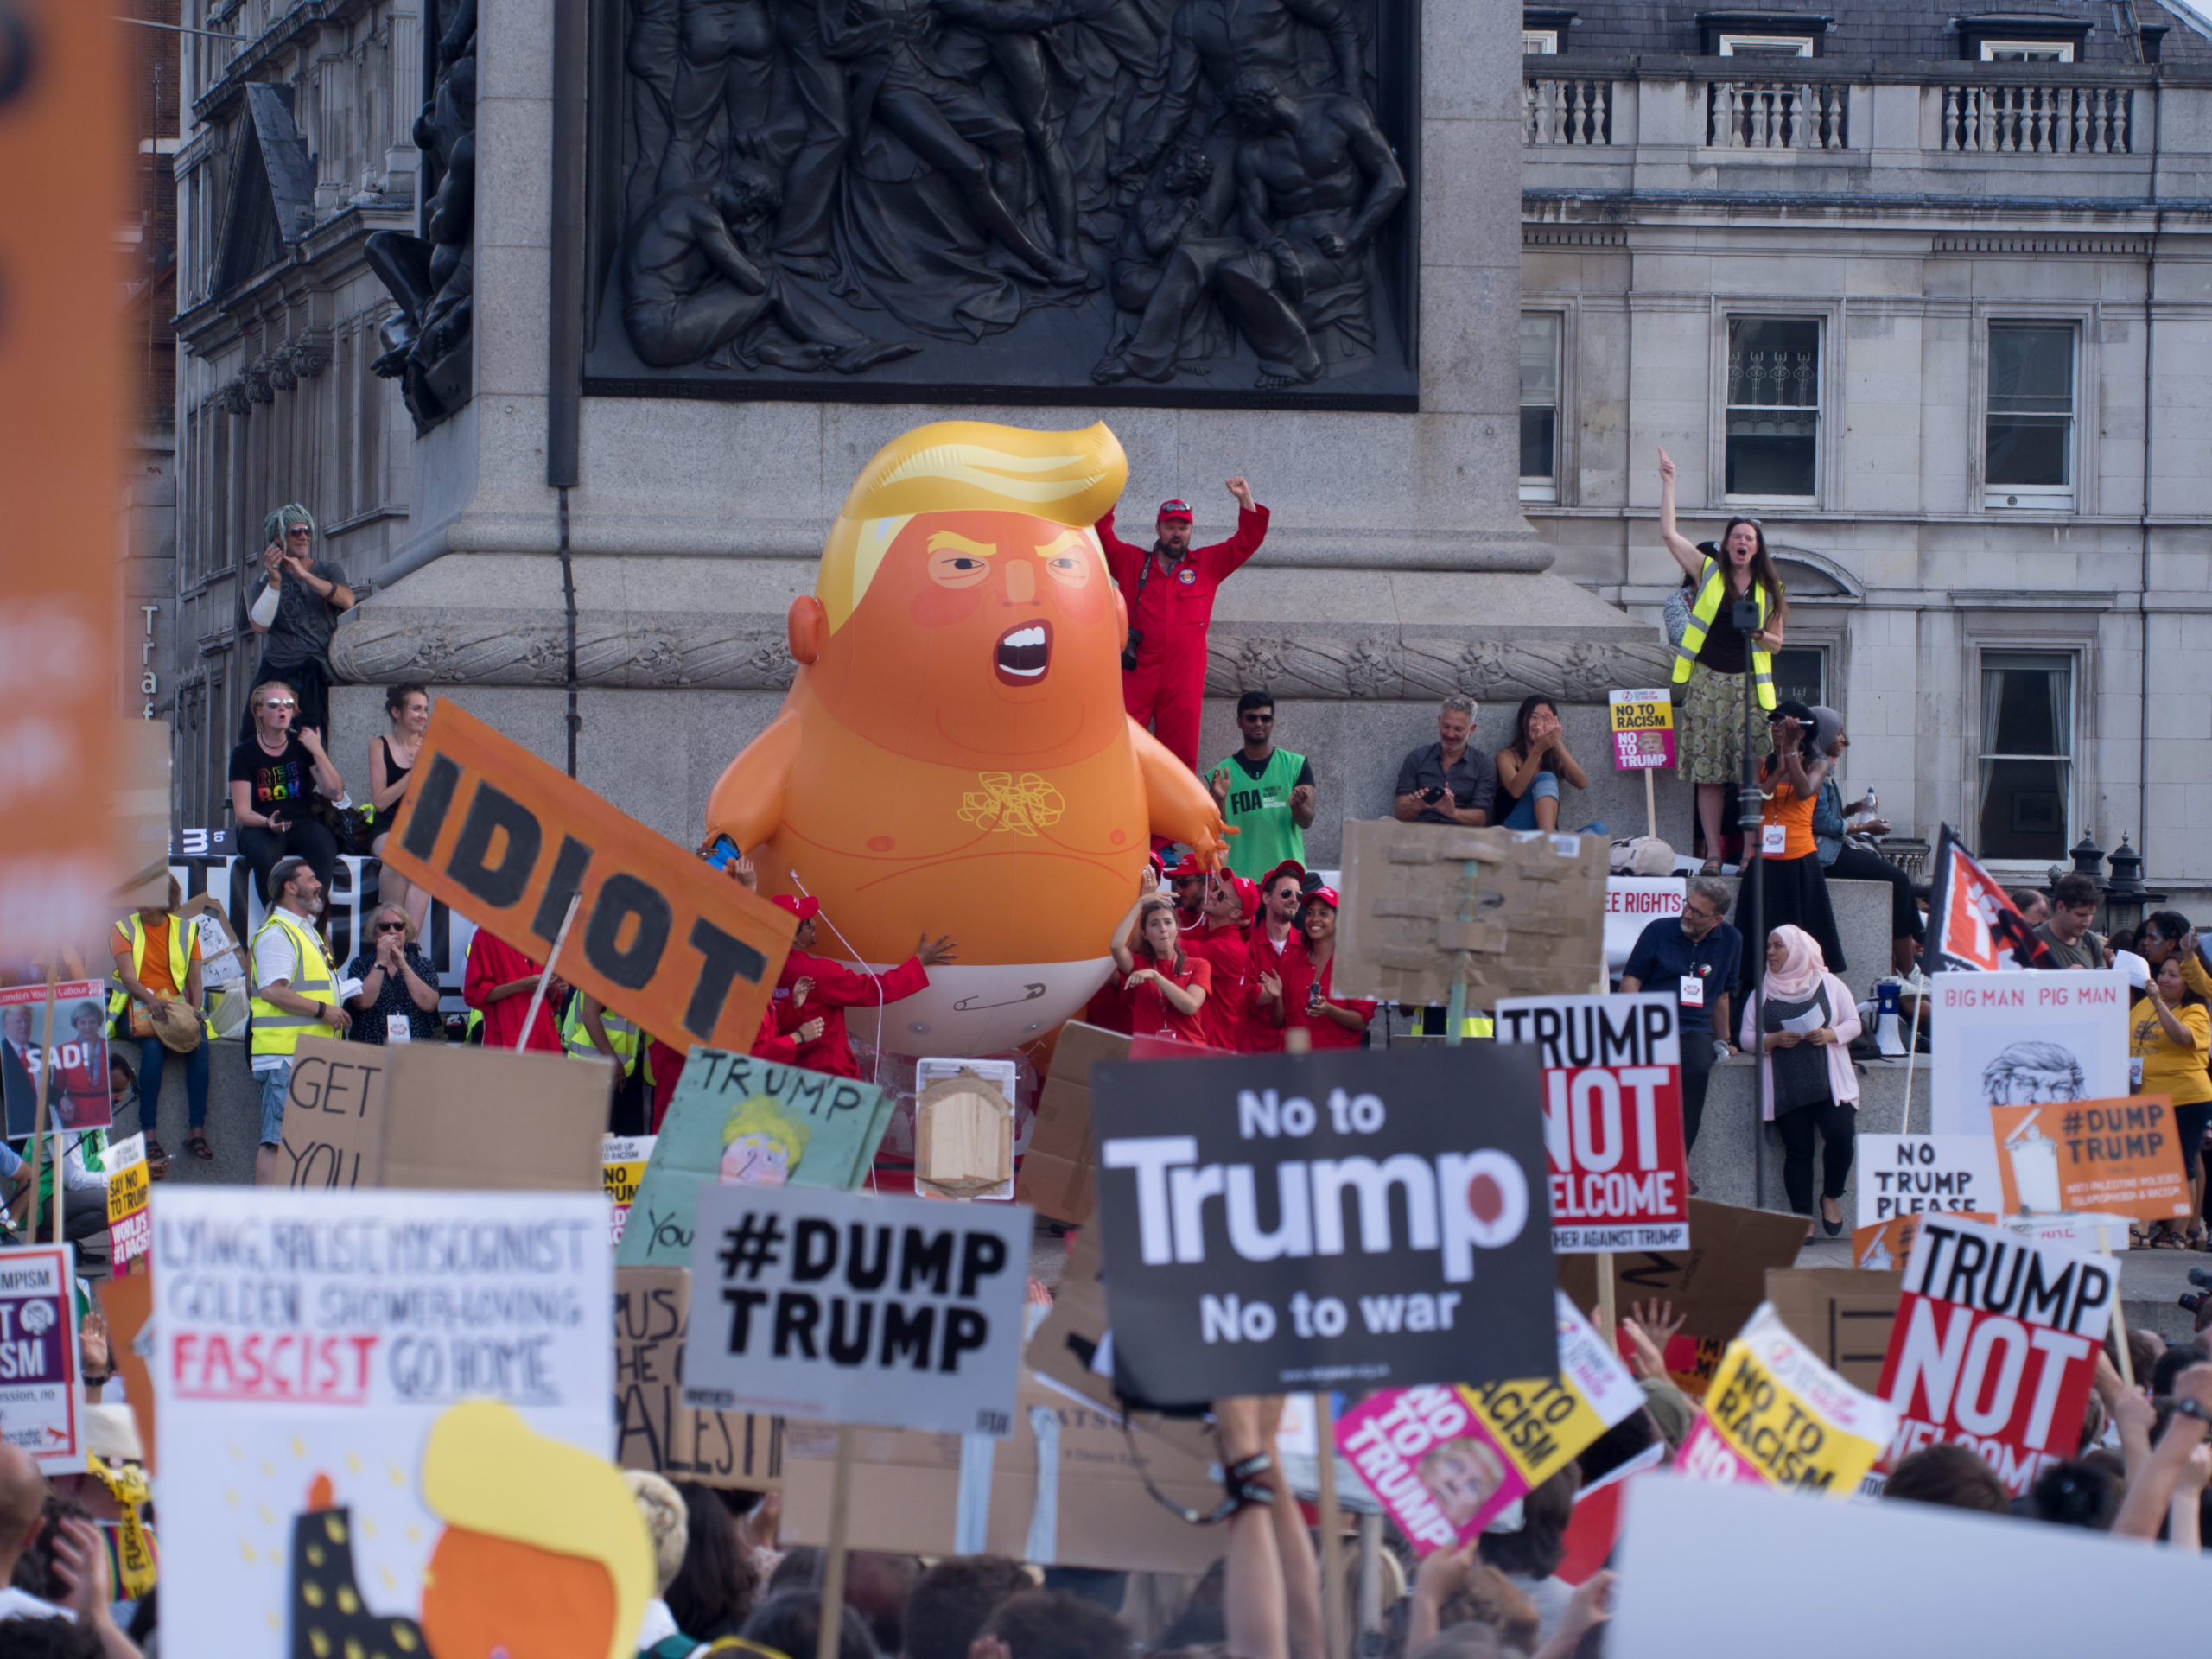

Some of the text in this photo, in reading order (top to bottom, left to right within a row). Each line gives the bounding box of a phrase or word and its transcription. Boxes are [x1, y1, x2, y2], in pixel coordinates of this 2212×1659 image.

[1616, 703, 1655, 716] NO TO
[1617, 715, 1666, 728] RACISM
[1618, 732, 1637, 744] NO
[1618, 744, 1637, 755] TO
[1619, 753, 1667, 768] TRUMP
[1230, 788, 1262, 815] FOA
[401, 750, 768, 1042] IDIOT
[1624, 892, 1681, 913] RIGHTS
[0, 991, 29, 1003] ondon
[58, 987, 86, 997] Labour
[1945, 986, 2116, 1007] BIG MAN PIG MAN
[25, 1042, 90, 1074] SAD!
[1502, 1003, 1673, 1068] TRUMP
[289, 1056, 382, 1118] GET
[699, 1051, 864, 1122] TRUMP
[1236, 1086, 1386, 1140] No to
[1543, 1067, 1670, 1173] NOT
[2063, 1104, 2164, 1135] #DUMP
[281, 1136, 361, 1193] YOU
[1897, 1142, 1936, 1166] NO
[2066, 1133, 2164, 1164] TRUMP
[110, 1170, 137, 1198] SAY NO
[110, 1183, 149, 1217] TO TRUMP
[603, 1167, 626, 1185] NO
[1548, 1171, 1678, 1217] ELCOME
[1874, 1171, 1973, 1195] TRUMP
[1102, 1135, 1530, 1284] Trump
[718, 1210, 1007, 1300] #DUMP
[1553, 1227, 1682, 1249] HER AGAINST TRUMP
[1920, 1224, 2112, 1333] TRUMP
[721, 1287, 989, 1376] TRUMP
[1200, 1291, 1462, 1344] No to war
[169, 1332, 554, 1397] FASCIST GO HOME
[1732, 1356, 1777, 1414] NO
[1889, 1294, 2091, 1452] NOT
[1376, 1395, 1432, 1457] TO
[1406, 1384, 1468, 1440] NO
[1474, 1382, 1560, 1469] ACISM
[1785, 1402, 1825, 1457] TO
[1715, 1387, 1836, 1498] RACISM
[1344, 1417, 1459, 1548] TRUMP
